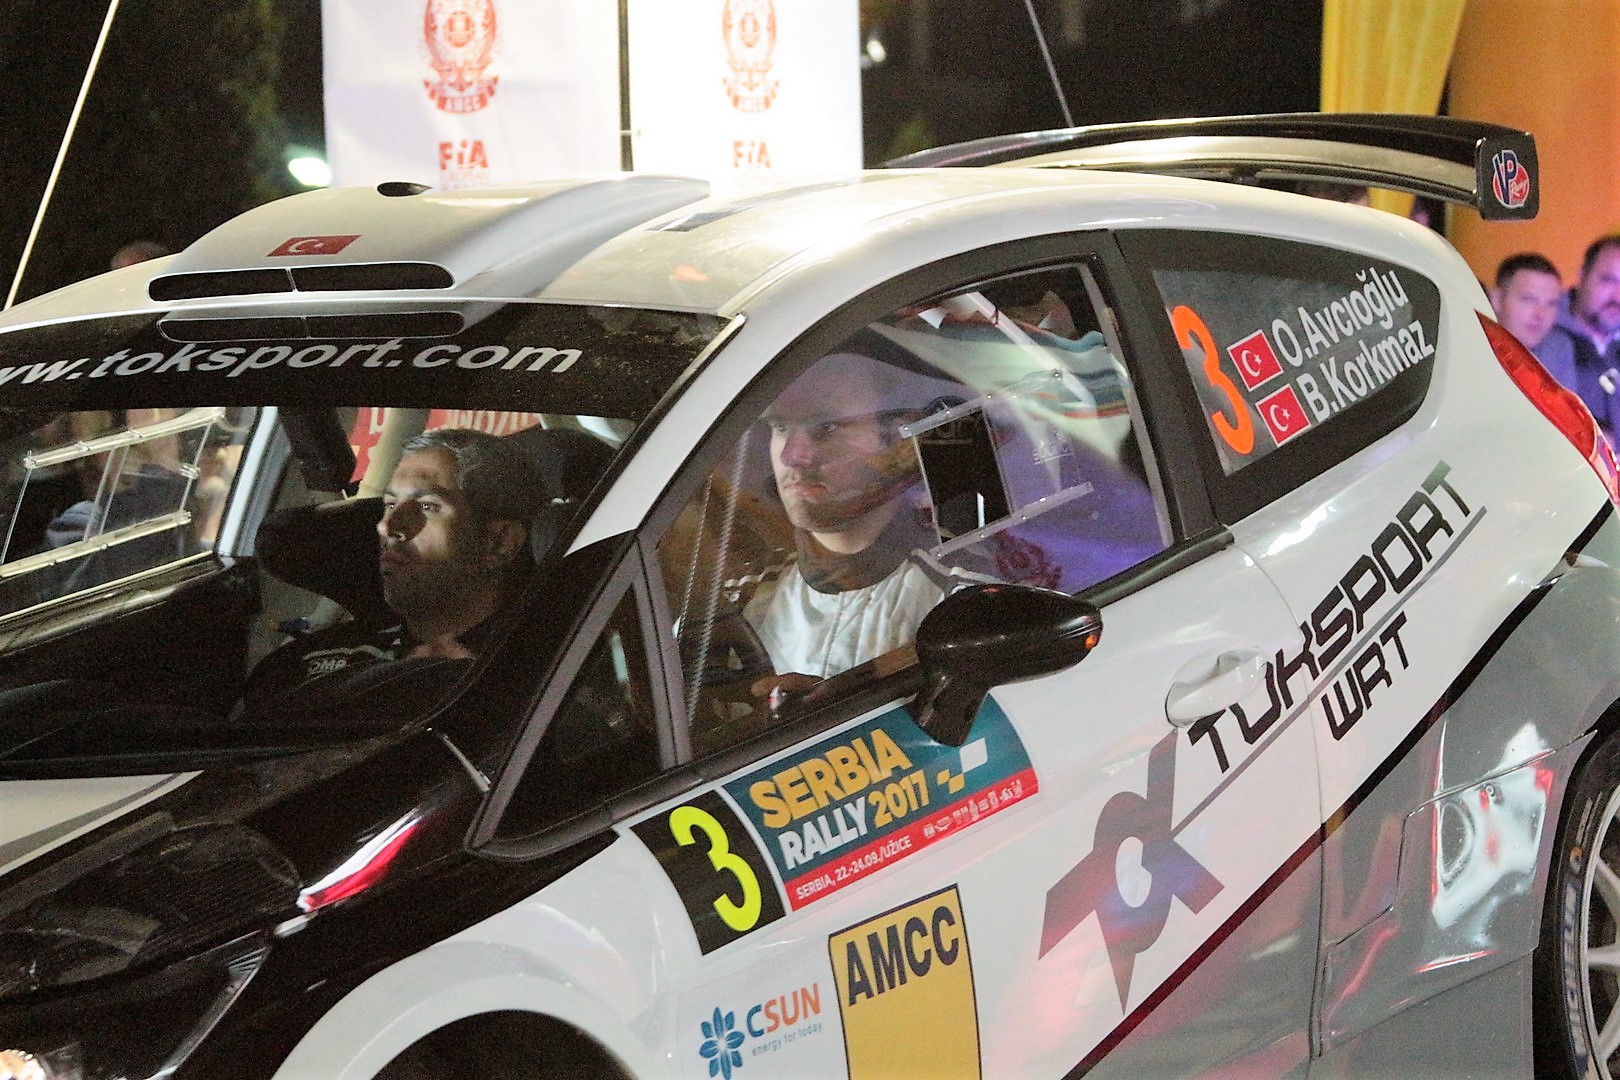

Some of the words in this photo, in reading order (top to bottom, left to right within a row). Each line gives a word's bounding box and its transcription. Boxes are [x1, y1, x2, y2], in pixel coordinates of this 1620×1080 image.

[1172, 304, 1255, 455] 3
[1295, 319, 1436, 423] B.Korkmaz
[1320, 610, 1408, 741] WRT
[749, 727, 913, 830] SERBIA
[777, 796, 869, 871] RALLY
[868, 769, 930, 829] 2017
[668, 805, 763, 932] 3
[796, 873, 836, 900] SERBIA,
[845, 905, 960, 1007] AMCC
[746, 982, 821, 1038] CSUN
